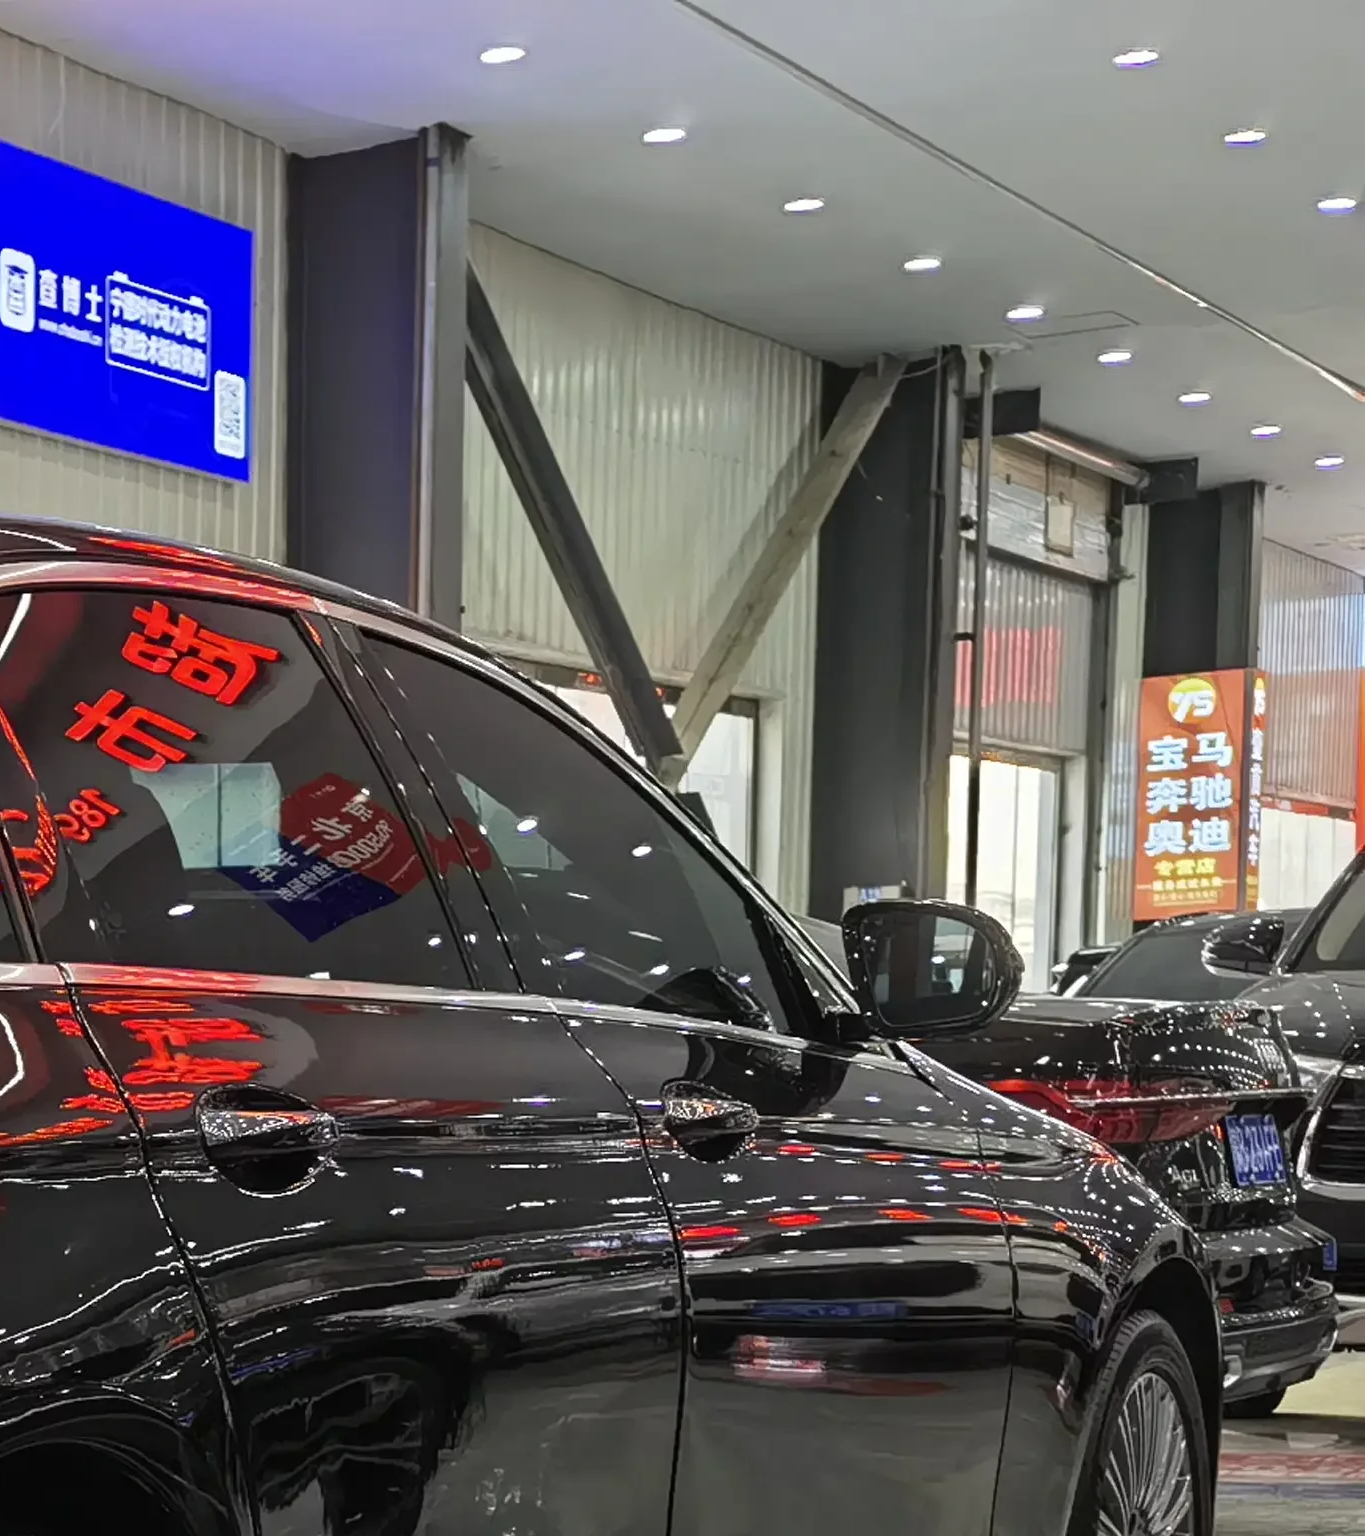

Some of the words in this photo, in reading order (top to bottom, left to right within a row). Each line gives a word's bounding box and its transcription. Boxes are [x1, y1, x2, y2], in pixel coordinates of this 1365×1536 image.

[1146, 731, 1234, 772] 宝马
[1145, 774, 1234, 815] 奔驰
[1143, 816, 1233, 857] 奥迪
